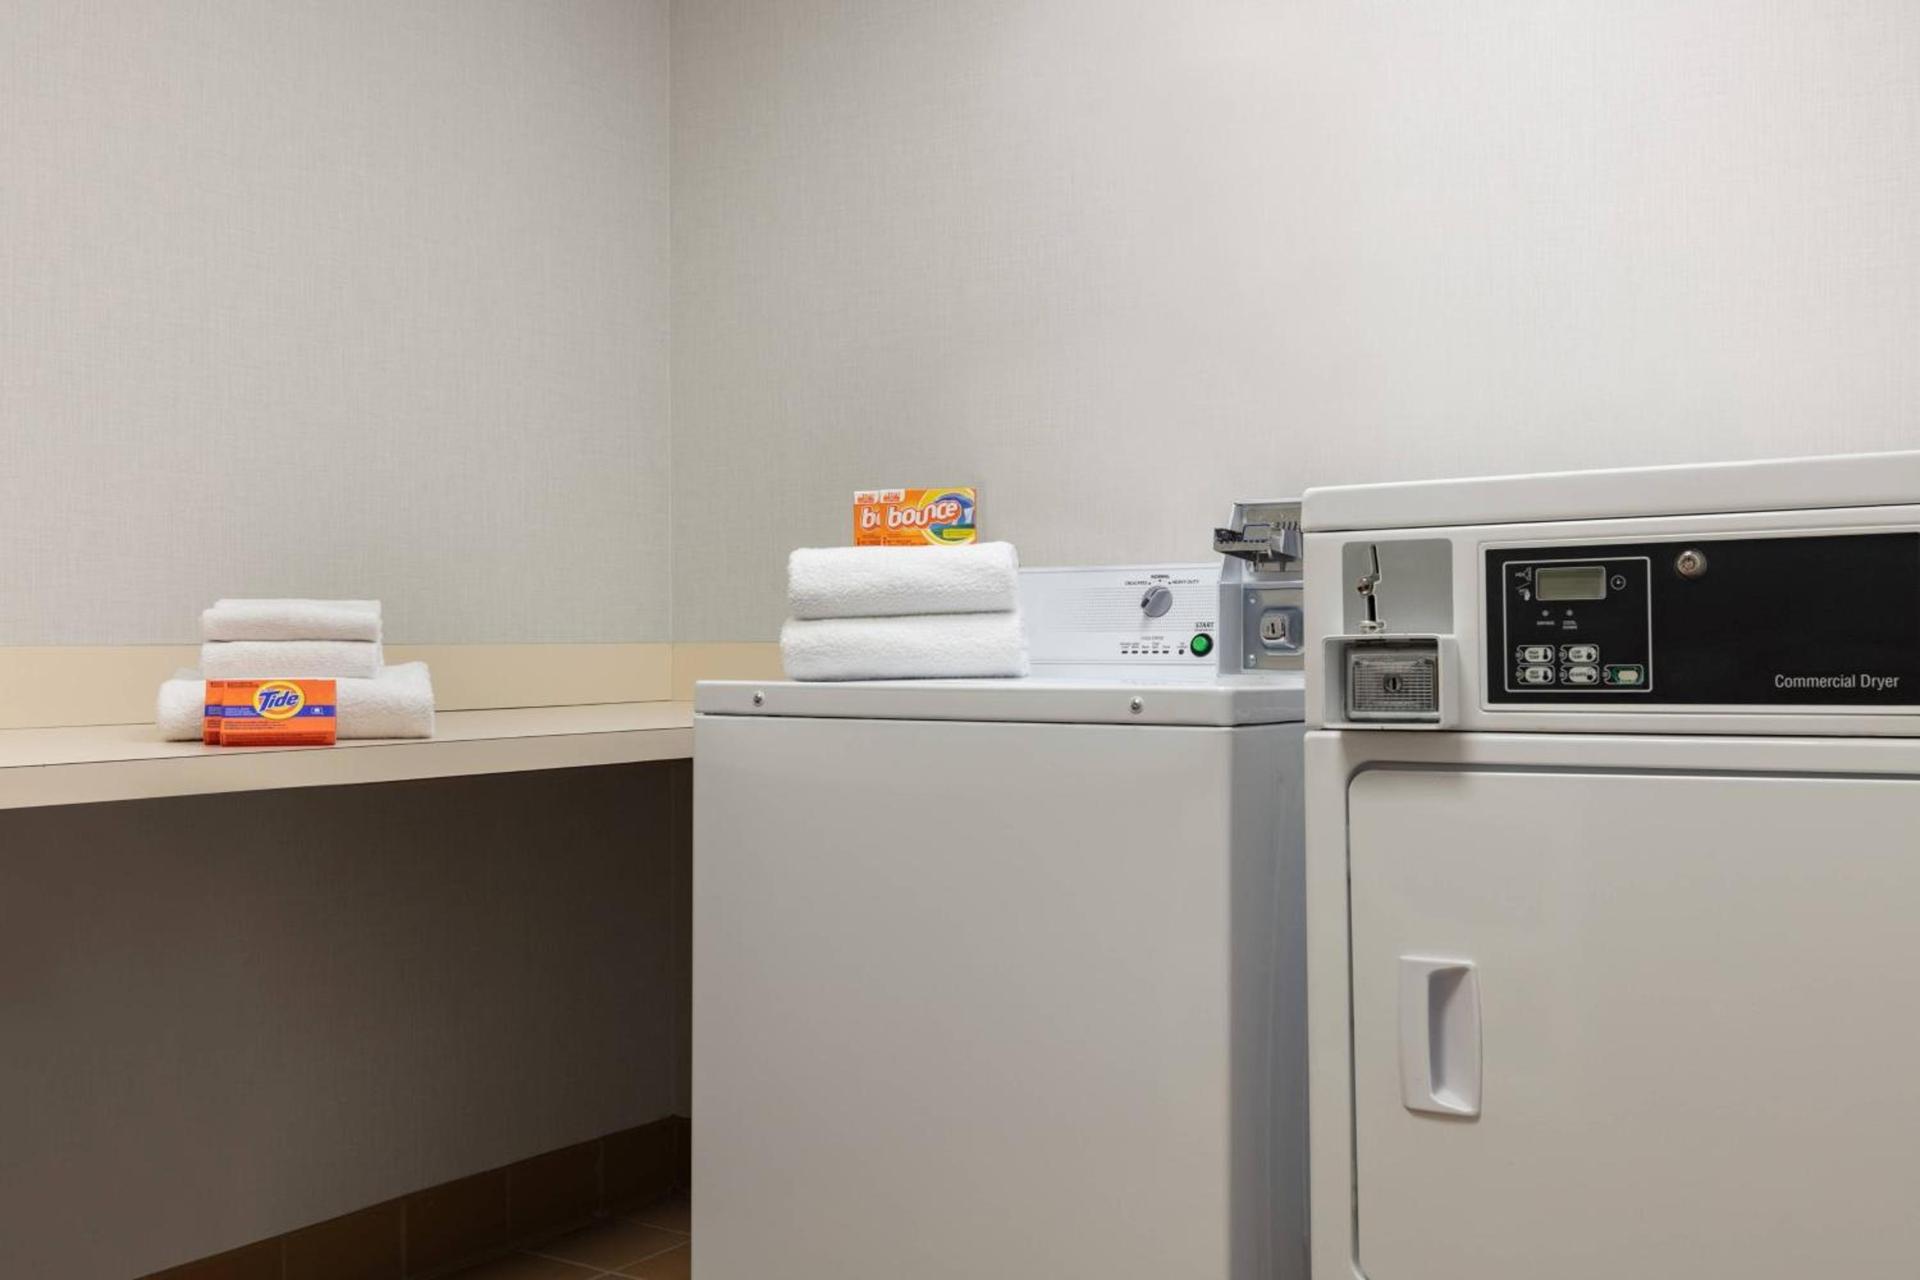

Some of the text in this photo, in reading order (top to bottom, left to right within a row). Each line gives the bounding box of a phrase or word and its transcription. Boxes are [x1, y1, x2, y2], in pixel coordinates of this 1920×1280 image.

[887, 502, 958, 528] bounce
[1774, 674, 1900, 691] Commercial Dryer
[259, 690, 299, 712] Tide
